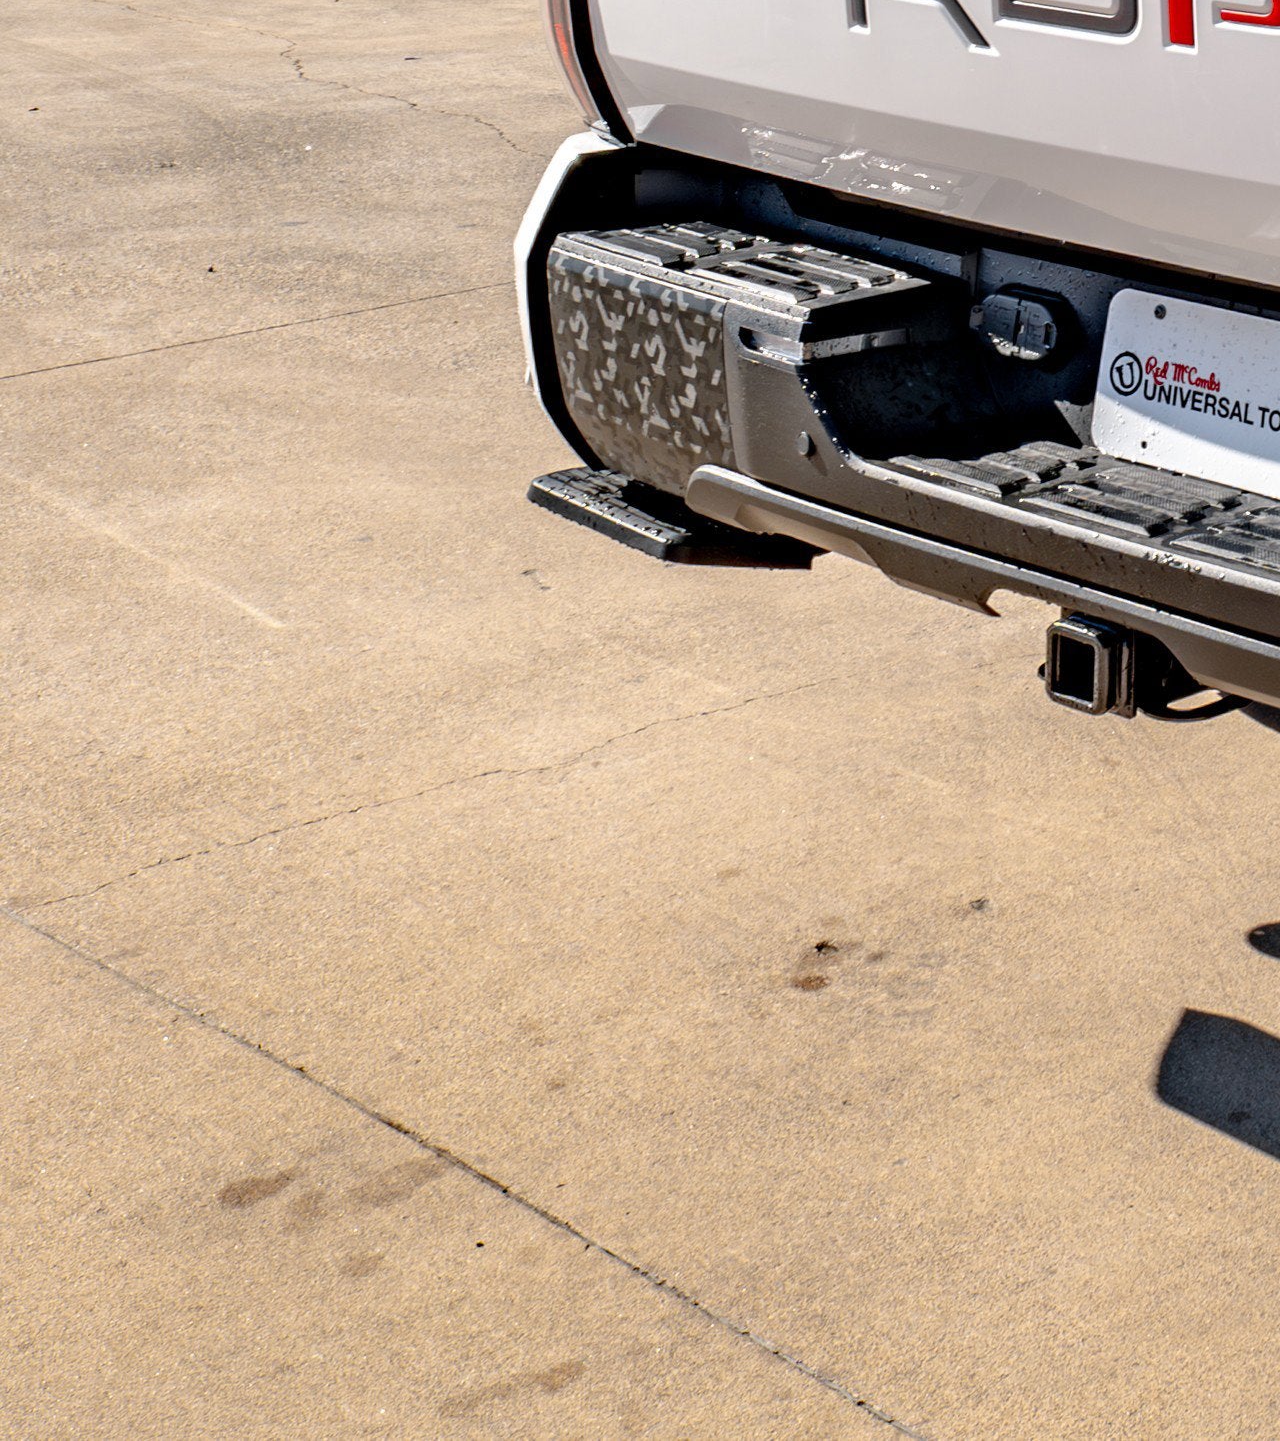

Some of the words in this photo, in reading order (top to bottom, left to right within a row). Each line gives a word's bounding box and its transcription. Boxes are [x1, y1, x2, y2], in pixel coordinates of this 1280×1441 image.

[1145, 356, 1169, 386] Red
[1172, 361, 1220, 392] McCombs
[1143, 379, 1254, 426] UNIVERSAL
